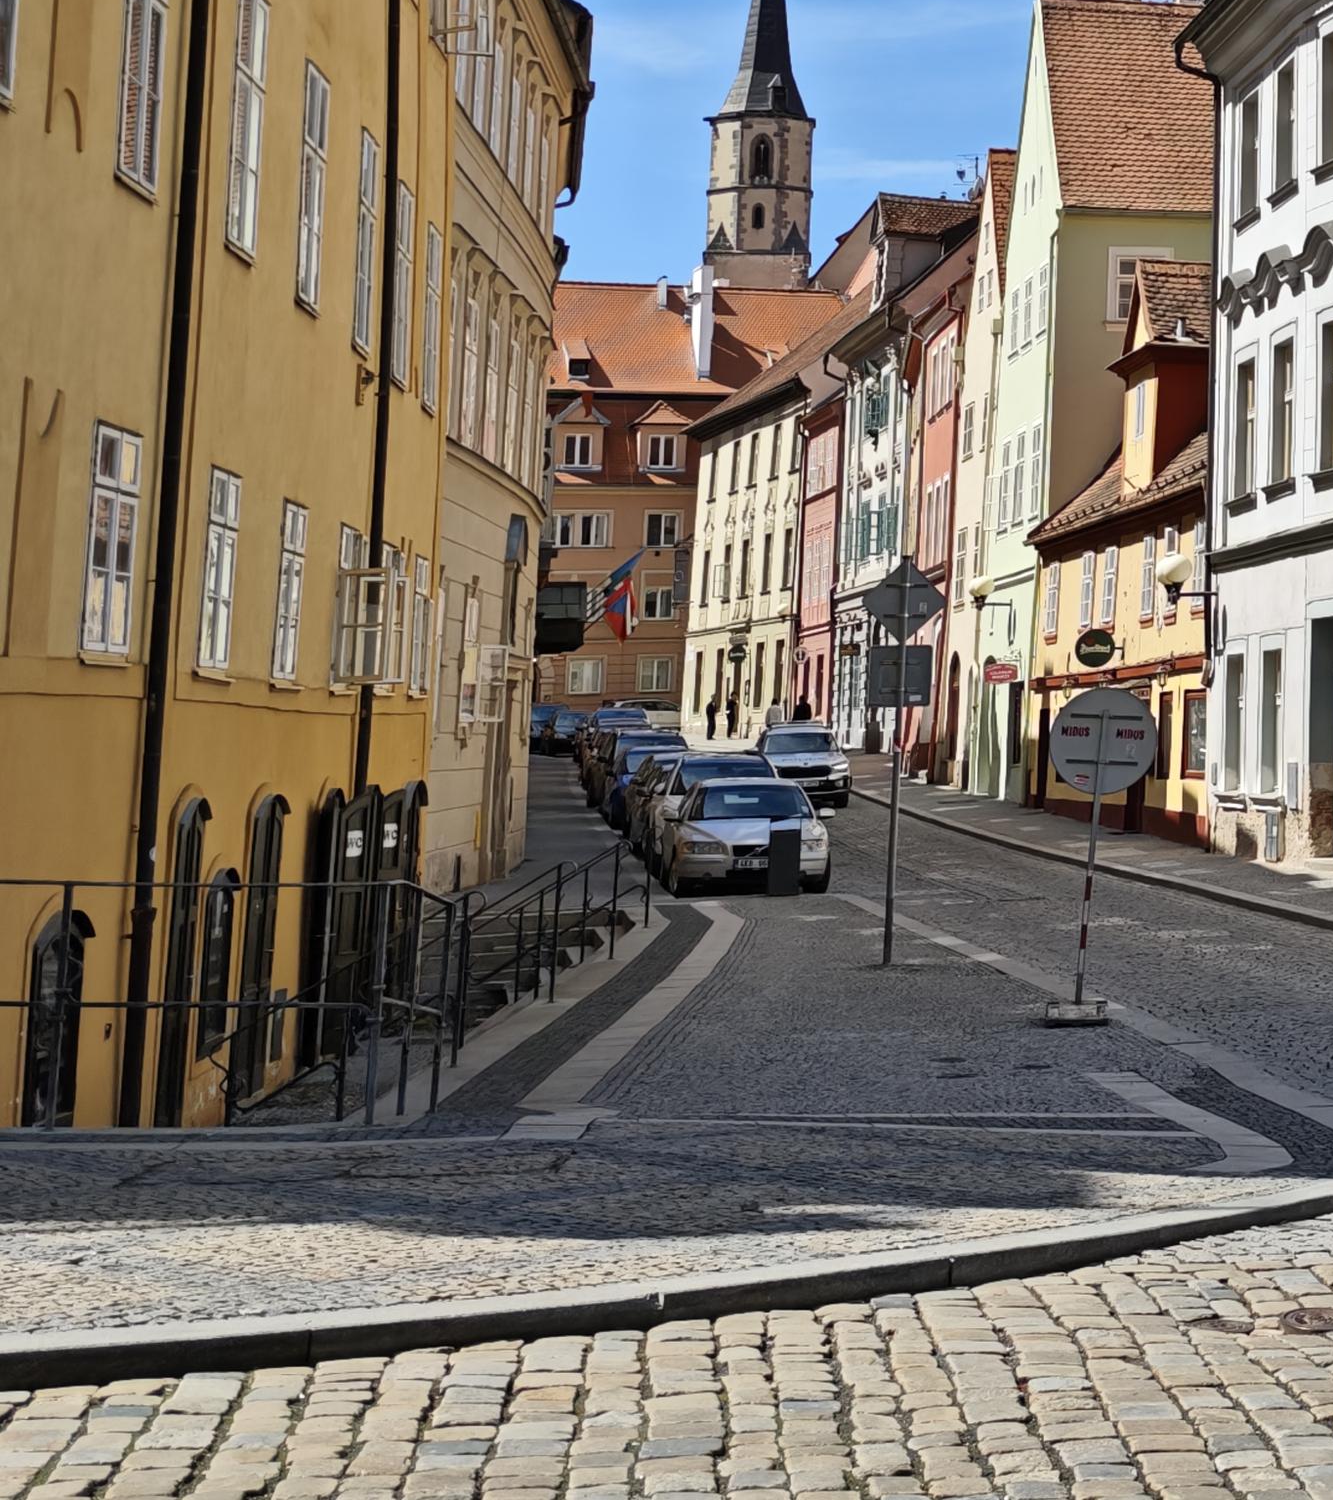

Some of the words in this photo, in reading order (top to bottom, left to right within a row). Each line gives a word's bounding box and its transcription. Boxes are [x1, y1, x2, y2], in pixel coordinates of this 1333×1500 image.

[1061, 725, 1091, 738] MIDUS
[1115, 727, 1146, 741] MIDUS
[347, 837, 363, 849] WC
